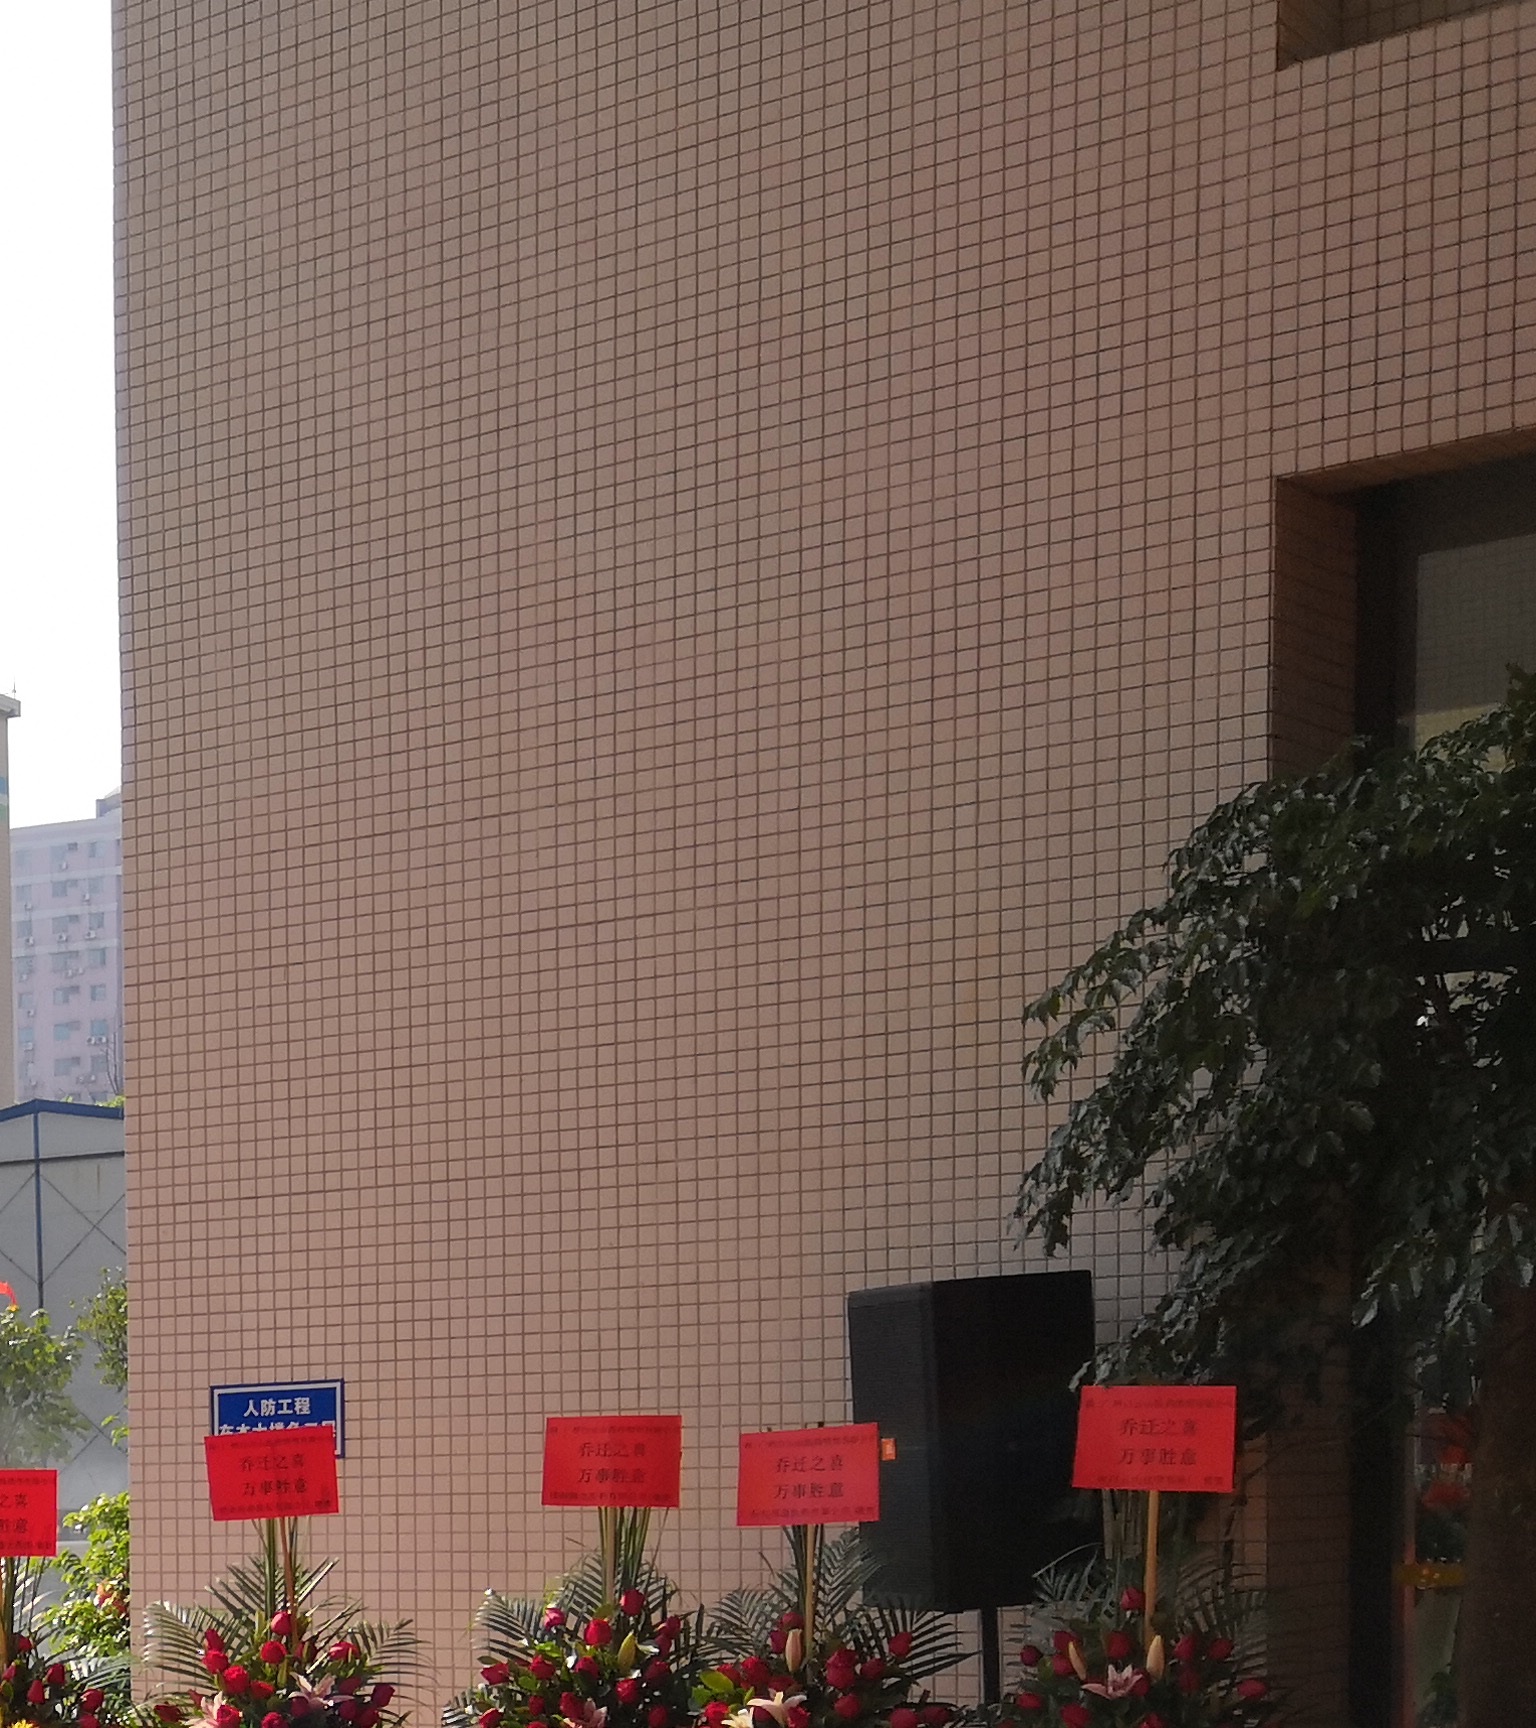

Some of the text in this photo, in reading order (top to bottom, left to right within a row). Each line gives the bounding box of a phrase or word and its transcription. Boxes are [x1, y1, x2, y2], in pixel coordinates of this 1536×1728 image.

[243, 1397, 311, 1417] 人防工程
[1120, 1417, 1198, 1436] 乔迁之喜
[776, 1454, 844, 1473] 乔迁之喜
